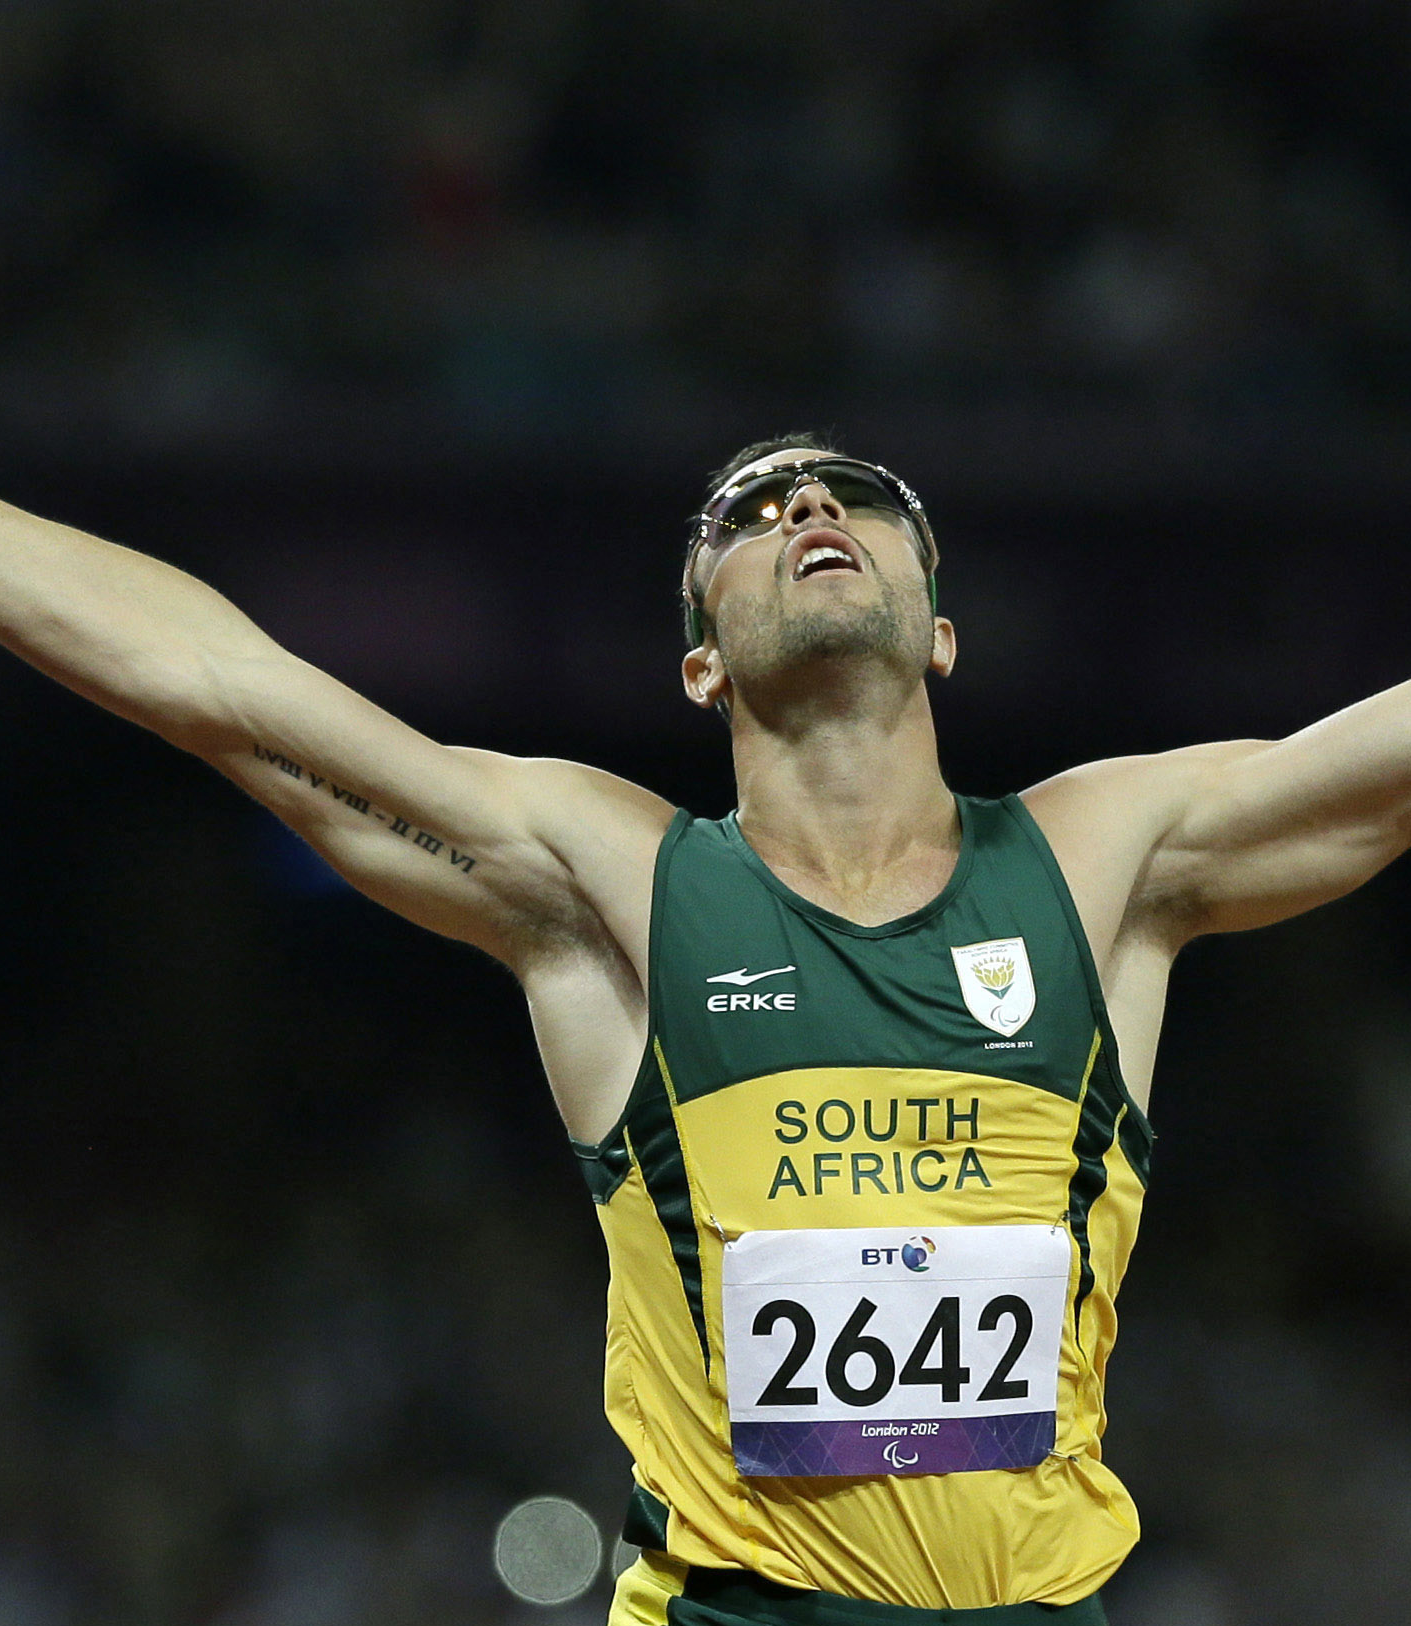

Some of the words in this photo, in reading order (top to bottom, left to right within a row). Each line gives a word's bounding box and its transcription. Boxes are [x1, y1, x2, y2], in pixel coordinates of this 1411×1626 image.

[308, 771, 326, 788] V
[332, 783, 371, 816] VIII
[388, 815, 411, 837] II
[413, 830, 444, 856] III
[450, 847, 477, 874] VI
[706, 991, 796, 1012] ERKE
[774, 1097, 980, 1143] SOUTH
[767, 1147, 992, 1200] AFRICA
[861, 1248, 900, 1266] BT
[750, 1294, 1034, 1408] 2642
[861, 1423, 909, 1437] London
[910, 1422, 940, 1436] 2012
